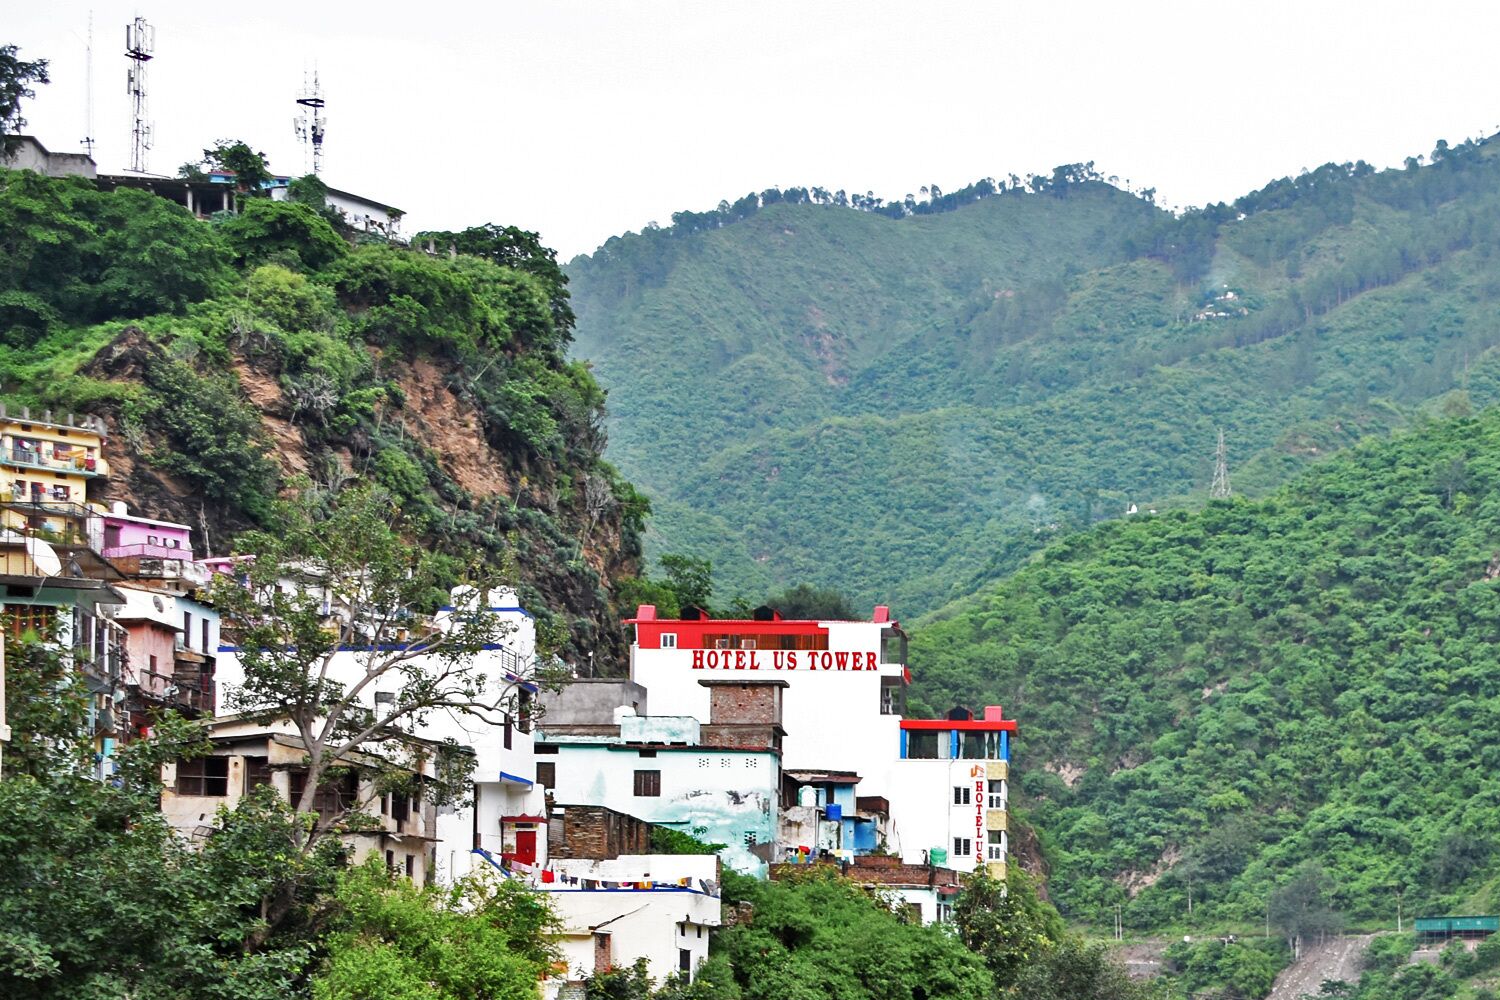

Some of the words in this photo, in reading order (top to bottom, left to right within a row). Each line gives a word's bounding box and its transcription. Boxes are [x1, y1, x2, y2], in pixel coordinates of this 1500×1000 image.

[692, 650, 760, 670] HOTEL
[773, 651, 797, 670] US
[808, 651, 878, 671] TOWER
[975, 781, 984, 838] HOTEL
[975, 841, 984, 864] US
